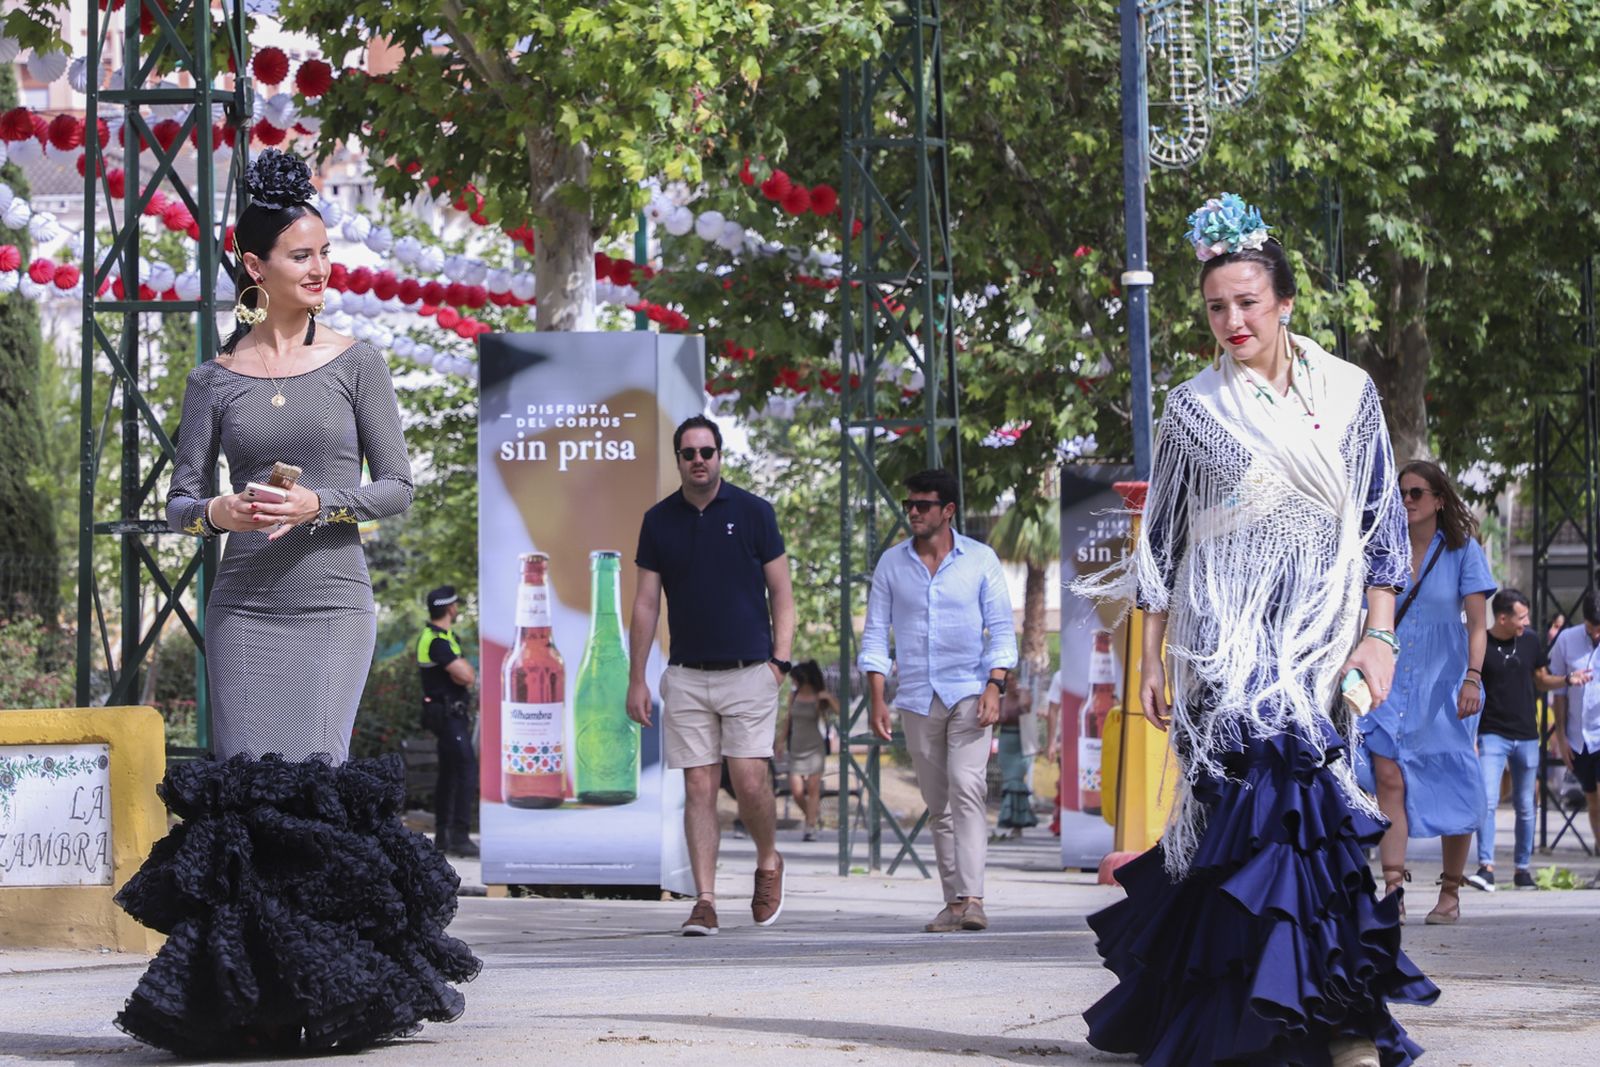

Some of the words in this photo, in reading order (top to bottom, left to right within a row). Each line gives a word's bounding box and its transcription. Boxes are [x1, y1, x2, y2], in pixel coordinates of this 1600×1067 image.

[527, 404, 610, 415] DISFRUTA
[516, 417, 547, 428] DEL
[555, 417, 621, 428] CORPUS
[500, 431, 547, 461] sin
[558, 431, 637, 472] prisa
[1077, 539, 1112, 562] sin
[69, 785, 106, 825] LA
